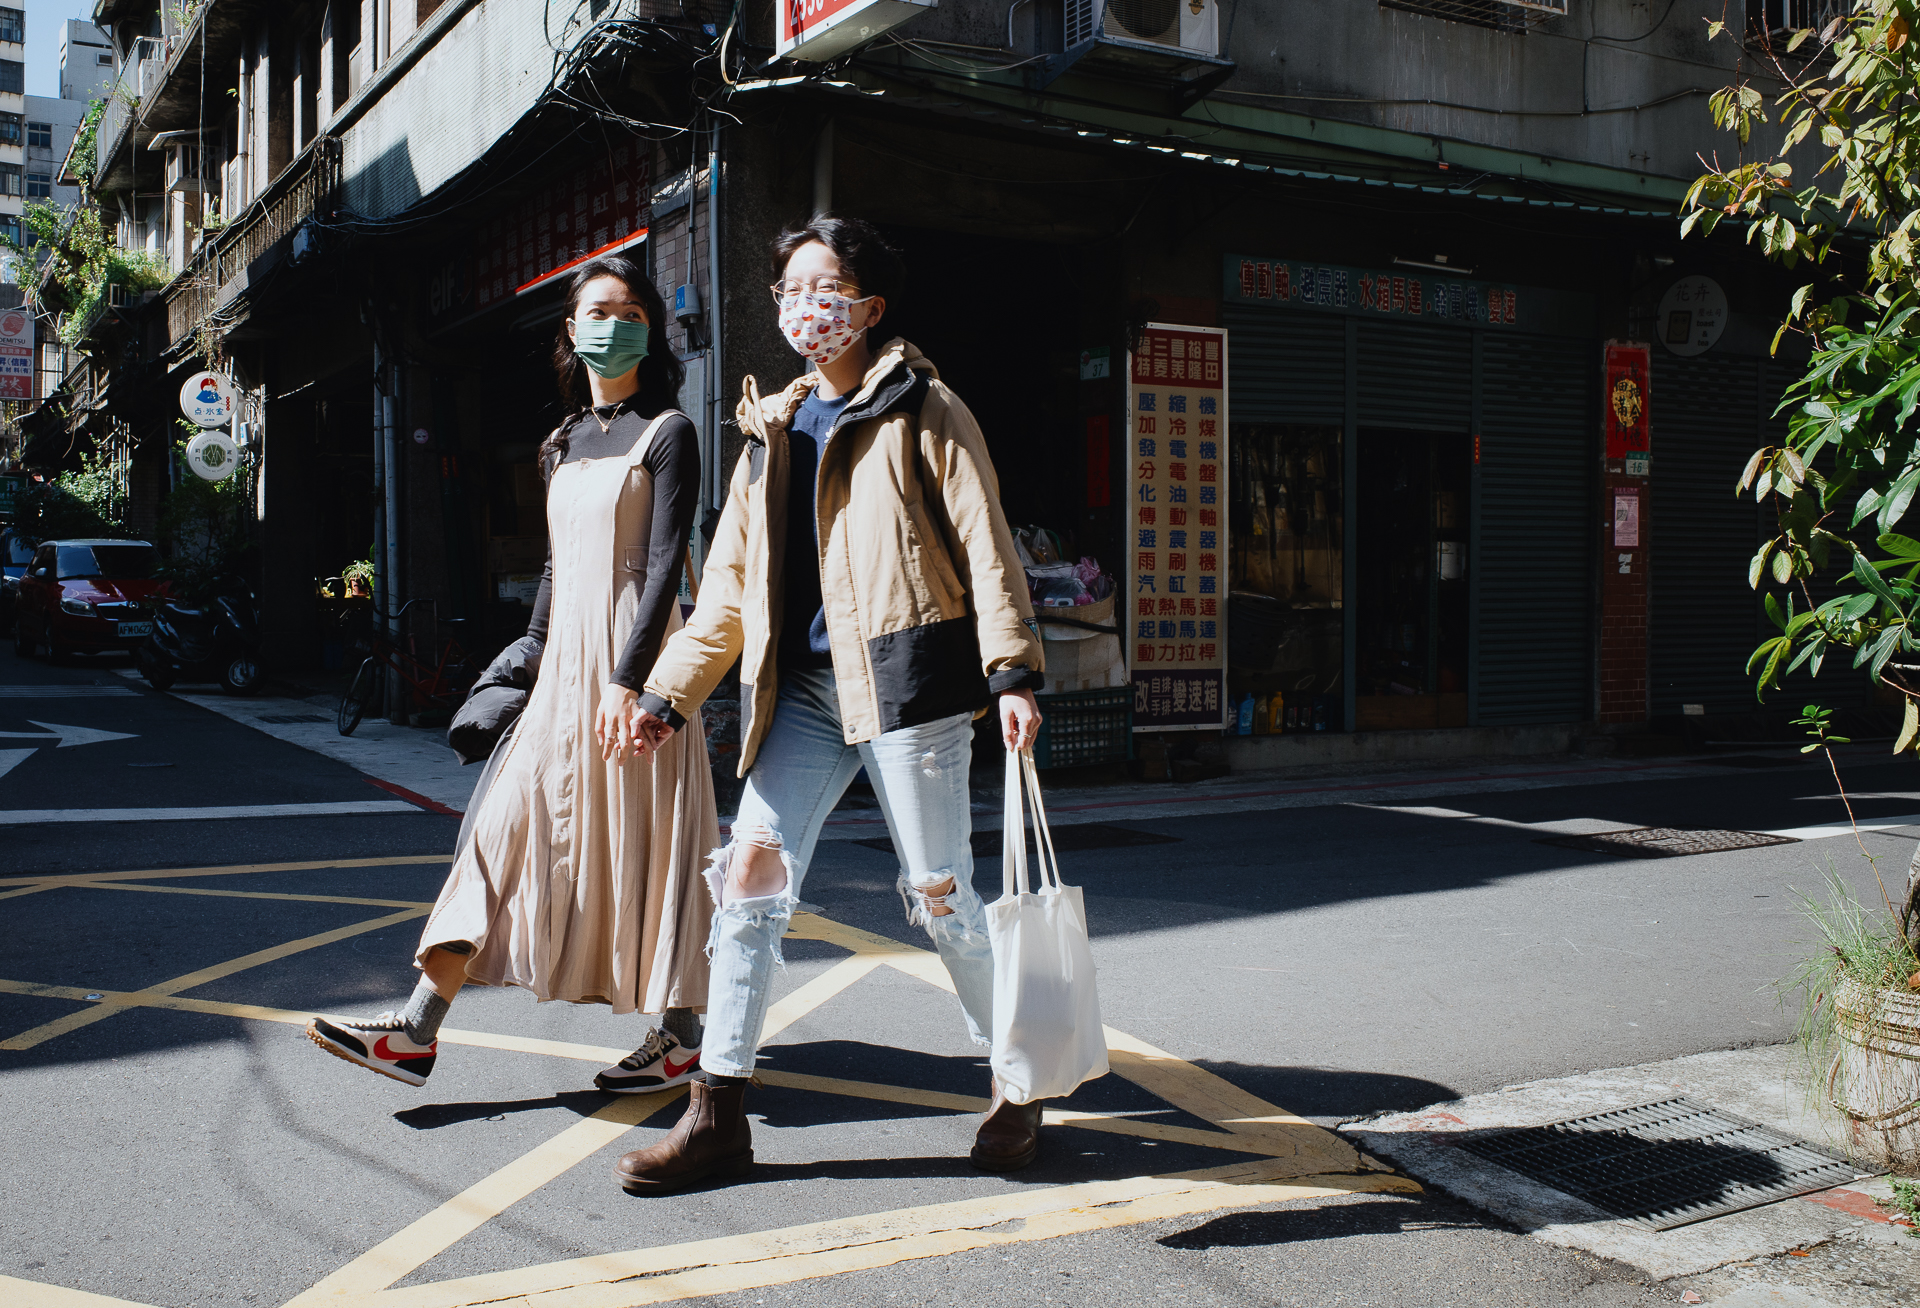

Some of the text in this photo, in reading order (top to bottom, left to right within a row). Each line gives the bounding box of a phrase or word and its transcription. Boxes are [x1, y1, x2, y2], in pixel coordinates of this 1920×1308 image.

[635, 134, 650, 230] 動力拉桿
[593, 157, 609, 251] 汽缸蓋
[614, 146, 630, 241] 發電機
[555, 181, 569, 268] 分電盤
[574, 169, 588, 260] 起動馬達
[506, 211, 519, 292] 水箱馬達
[430, 260, 455, 316] elf
[1675, 283, 1710, 302] 花卉
[1153, 337, 1168, 378] 三菱
[1170, 338, 1185, 379] 喜美
[1188, 340, 1202, 380] 裕隆
[1205, 341, 1219, 381] 豐田
[1092, 363, 1104, 377] 37
[1138, 392, 1217, 415] 壓縮機
[1138, 416, 1217, 437] 加冷煤
[1138, 438, 1217, 460] 發電機
[1138, 461, 1217, 482] 分電盤
[1138, 484, 1217, 504] 化油器
[1138, 506, 1217, 527] 傳動軸
[1138, 529, 1217, 549] 避震器
[1138, 552, 1217, 571] 雨刷機
[1138, 574, 1217, 594] 汽缸蓋
[1138, 597, 1217, 616] 散熱馬達
[119, 624, 152, 635] AFM-0627
[1138, 620, 1217, 639] 起動馬達
[1138, 643, 1217, 662] 動力拉桿
[1134, 676, 1218, 717] 改 自排 手排 變速箱
